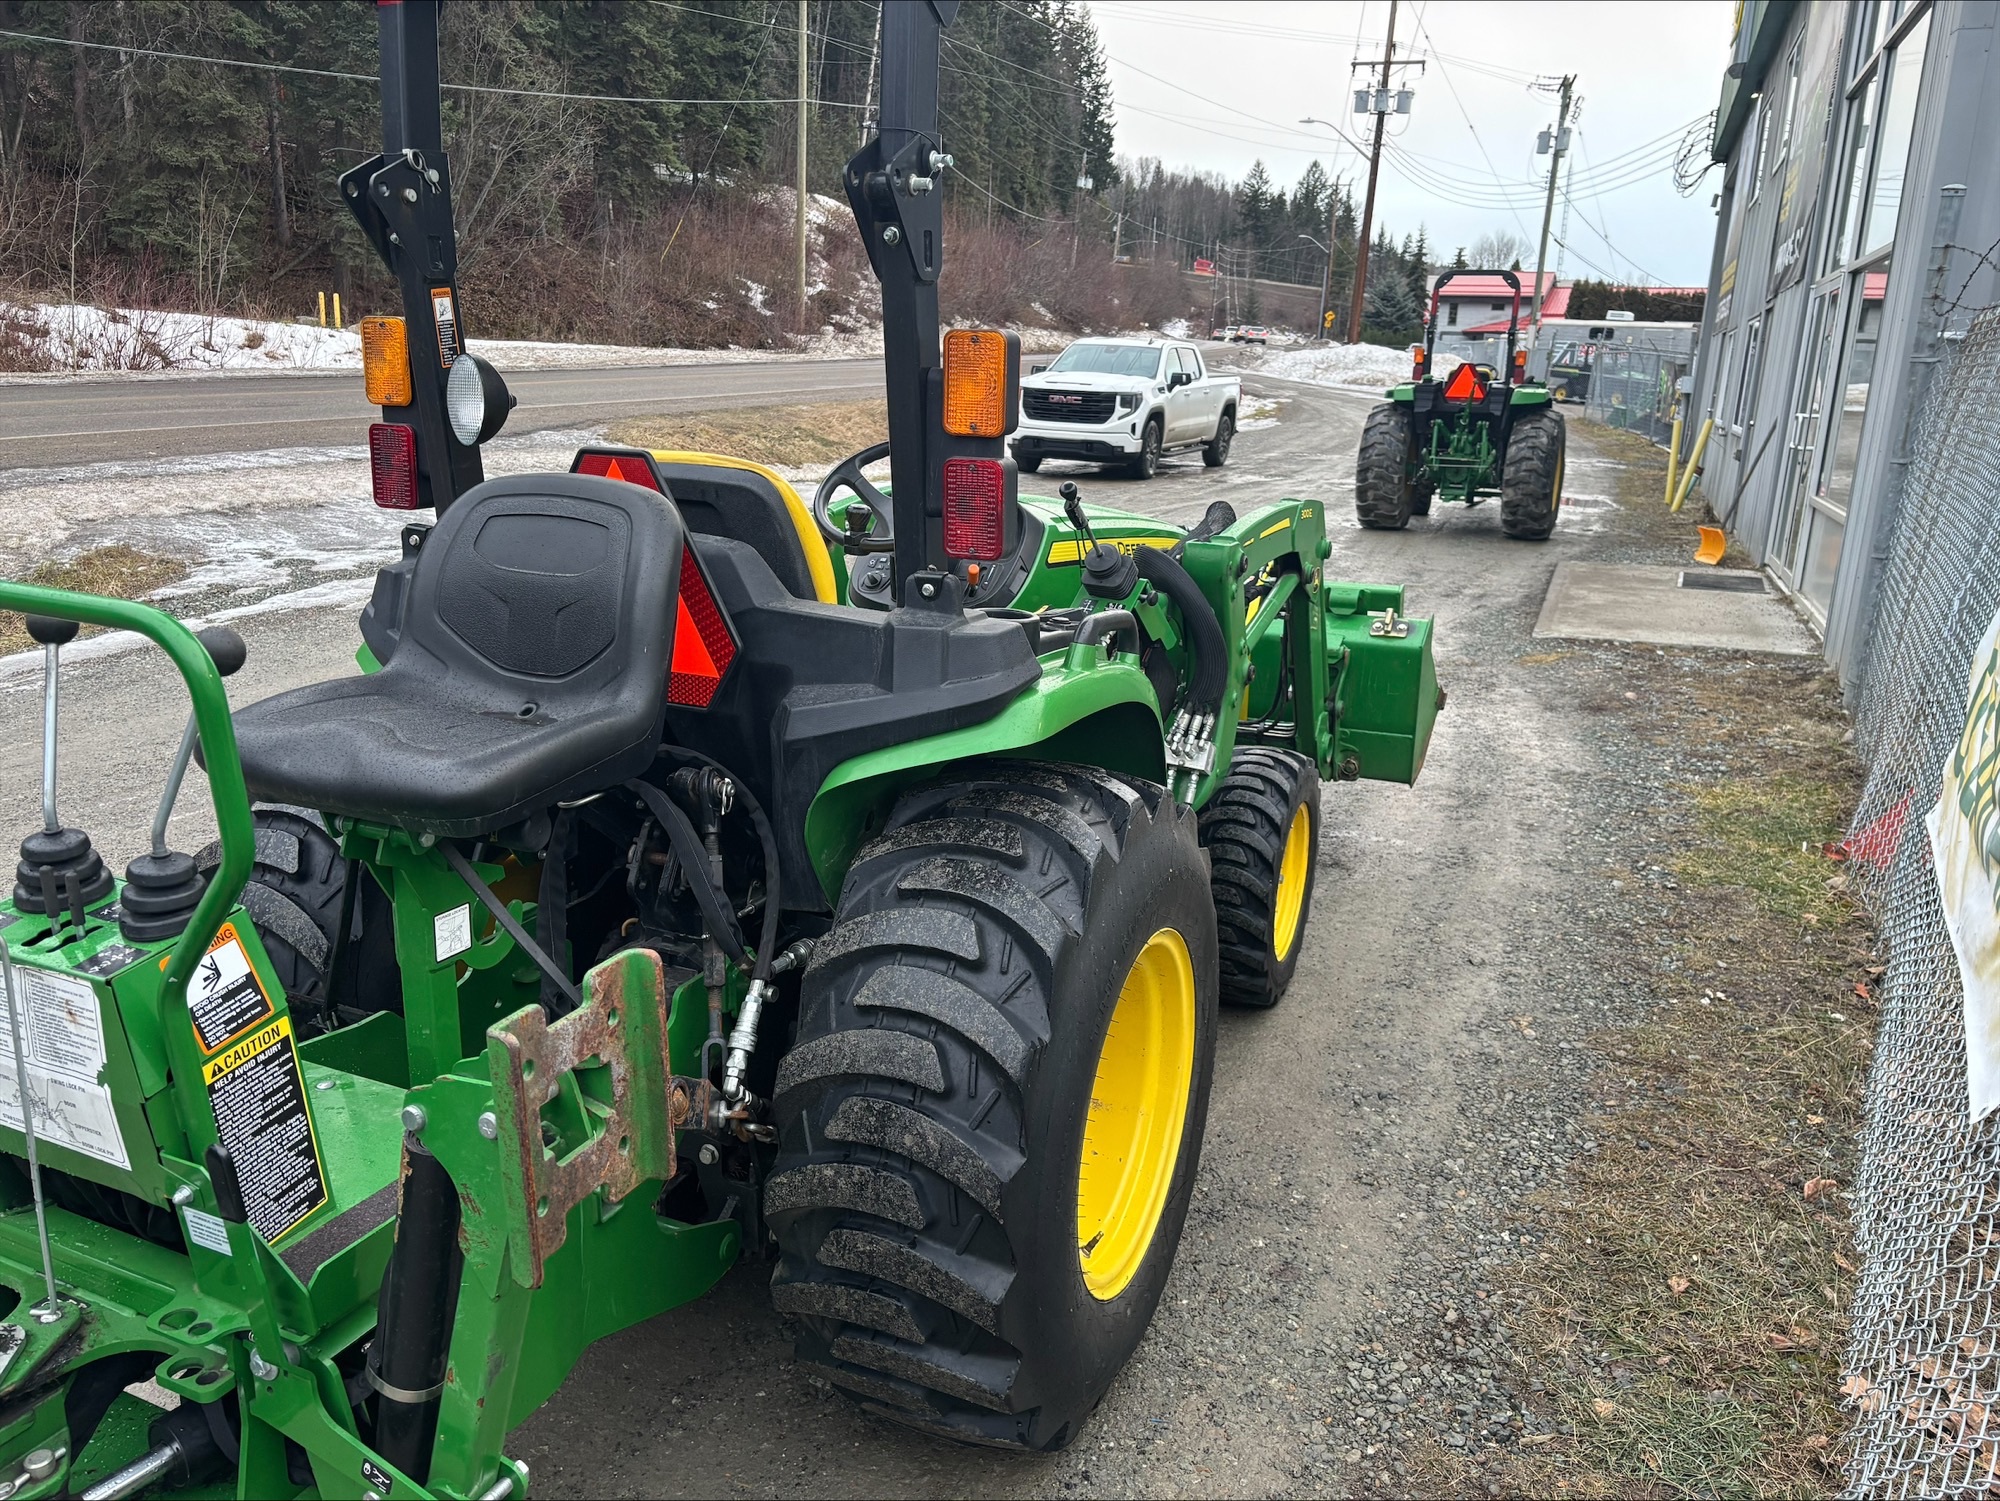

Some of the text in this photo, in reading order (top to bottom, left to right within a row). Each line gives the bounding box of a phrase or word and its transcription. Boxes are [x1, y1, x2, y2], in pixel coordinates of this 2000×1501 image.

[1048, 395, 1083, 404] GMC
[1301, 508, 1313, 519] 300E
[1117, 542, 1147, 559] DEE
[192, 975, 246, 1012] AVOID CRUSH INJURY
[194, 997, 222, 1017] OR DEATH
[215, 1027, 226, 1037] NOT
[223, 1024, 280, 1069] CAUTION
[214, 1041, 282, 1090] HELP AVOID INJURY
